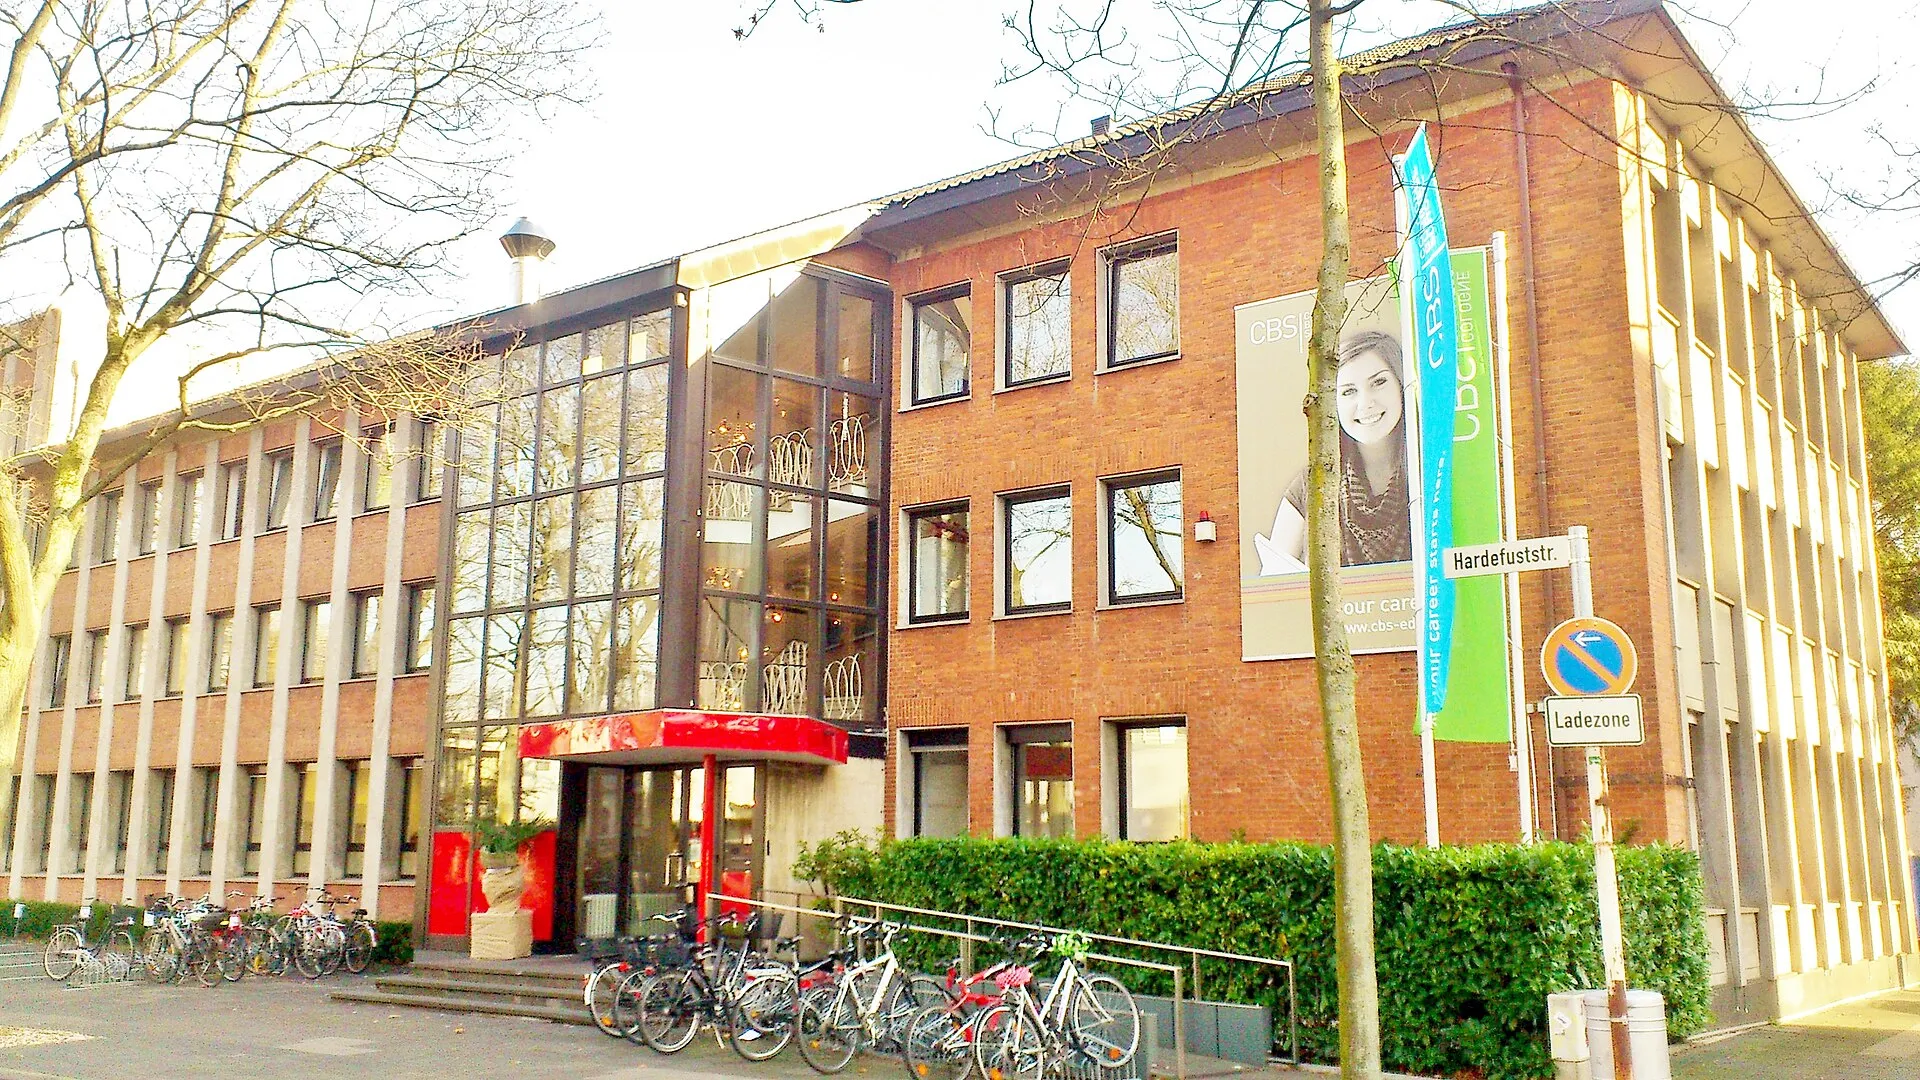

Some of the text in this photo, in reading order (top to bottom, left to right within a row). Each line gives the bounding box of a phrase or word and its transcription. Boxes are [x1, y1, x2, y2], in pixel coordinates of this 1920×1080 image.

[1249, 313, 1298, 346] CBS
[1453, 544, 1558, 571] Hardefuststr.
[1343, 599, 1375, 616] our
[1428, 574, 1441, 643] career
[1343, 616, 1416, 634] ww.cbs-ed
[1554, 710, 1631, 730] Ladezone
